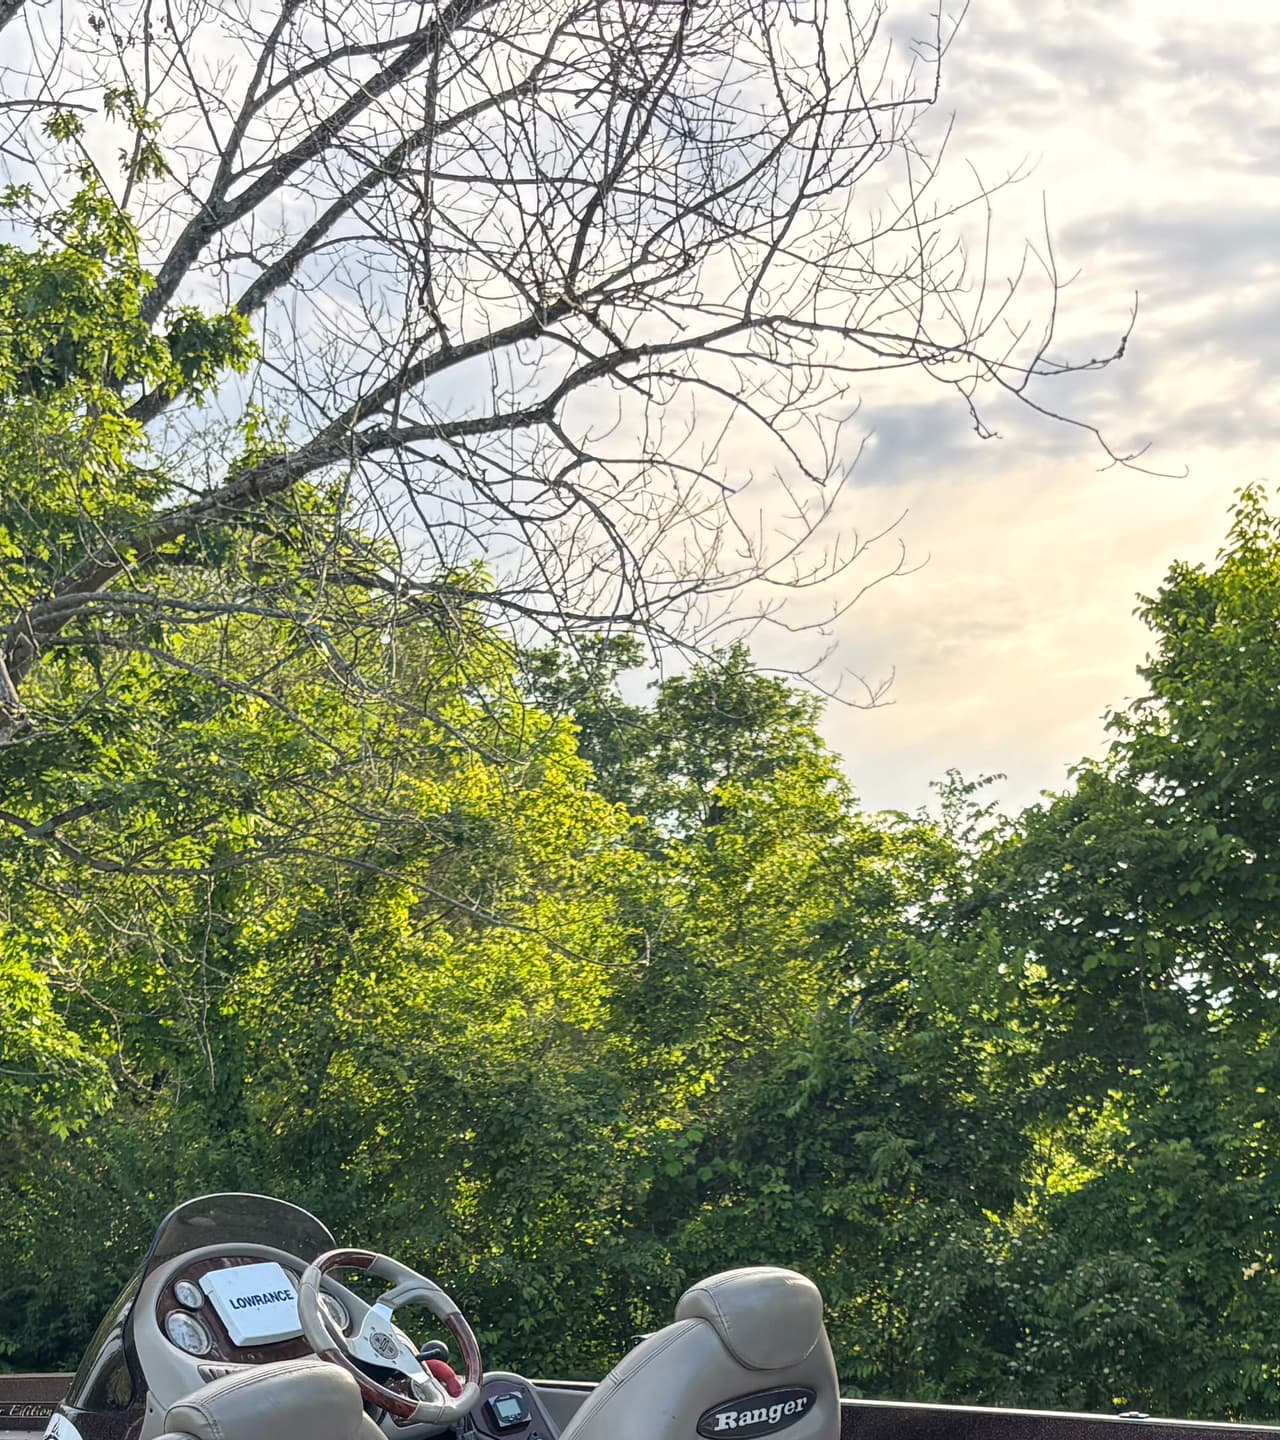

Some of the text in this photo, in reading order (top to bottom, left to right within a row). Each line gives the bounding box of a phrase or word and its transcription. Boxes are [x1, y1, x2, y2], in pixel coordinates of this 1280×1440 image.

[229, 1289, 295, 1311] LOWRANCE
[9, 1403, 53, 1417] Edition
[714, 1397, 808, 1431] Ranger
